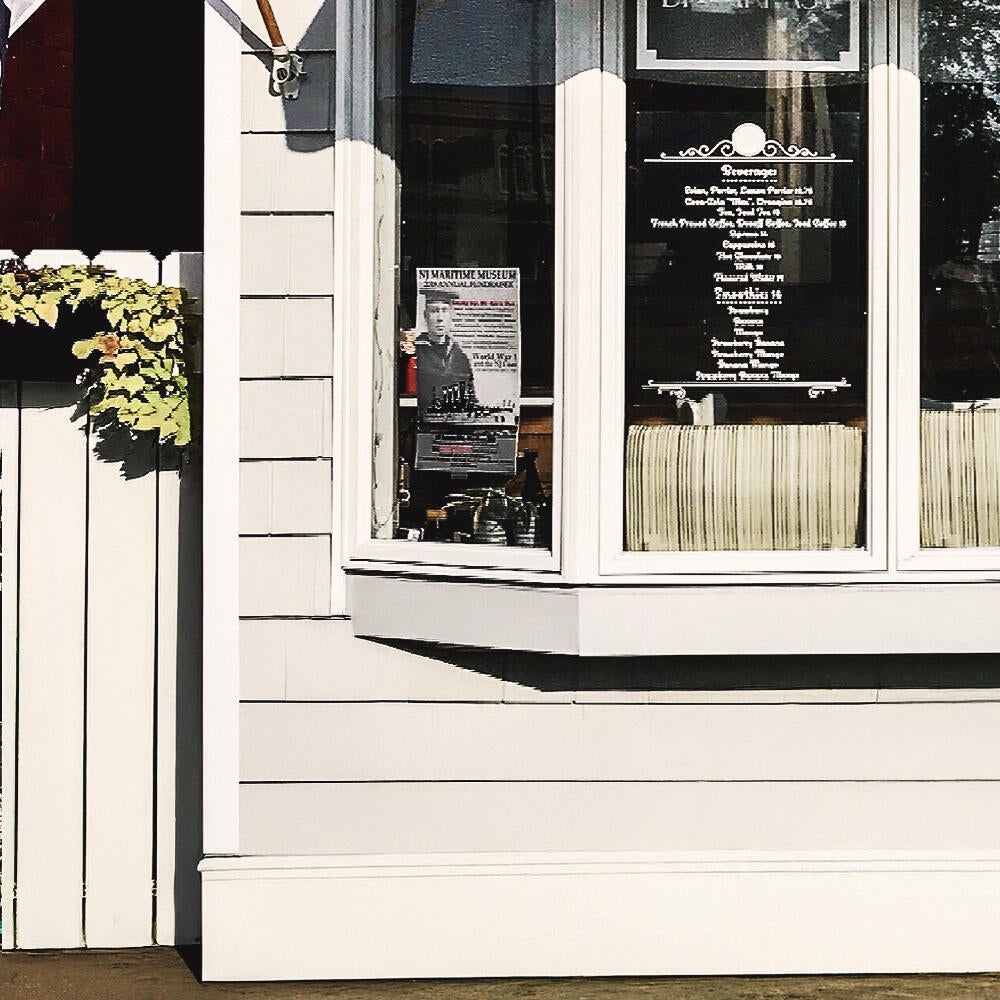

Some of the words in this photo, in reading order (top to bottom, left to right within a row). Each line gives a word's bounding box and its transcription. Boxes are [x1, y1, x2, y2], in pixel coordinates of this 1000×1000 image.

[721, 164, 777, 179] Beverages
[431, 270, 476, 280] MARITIME
[478, 270, 517, 280] MUSEUM
